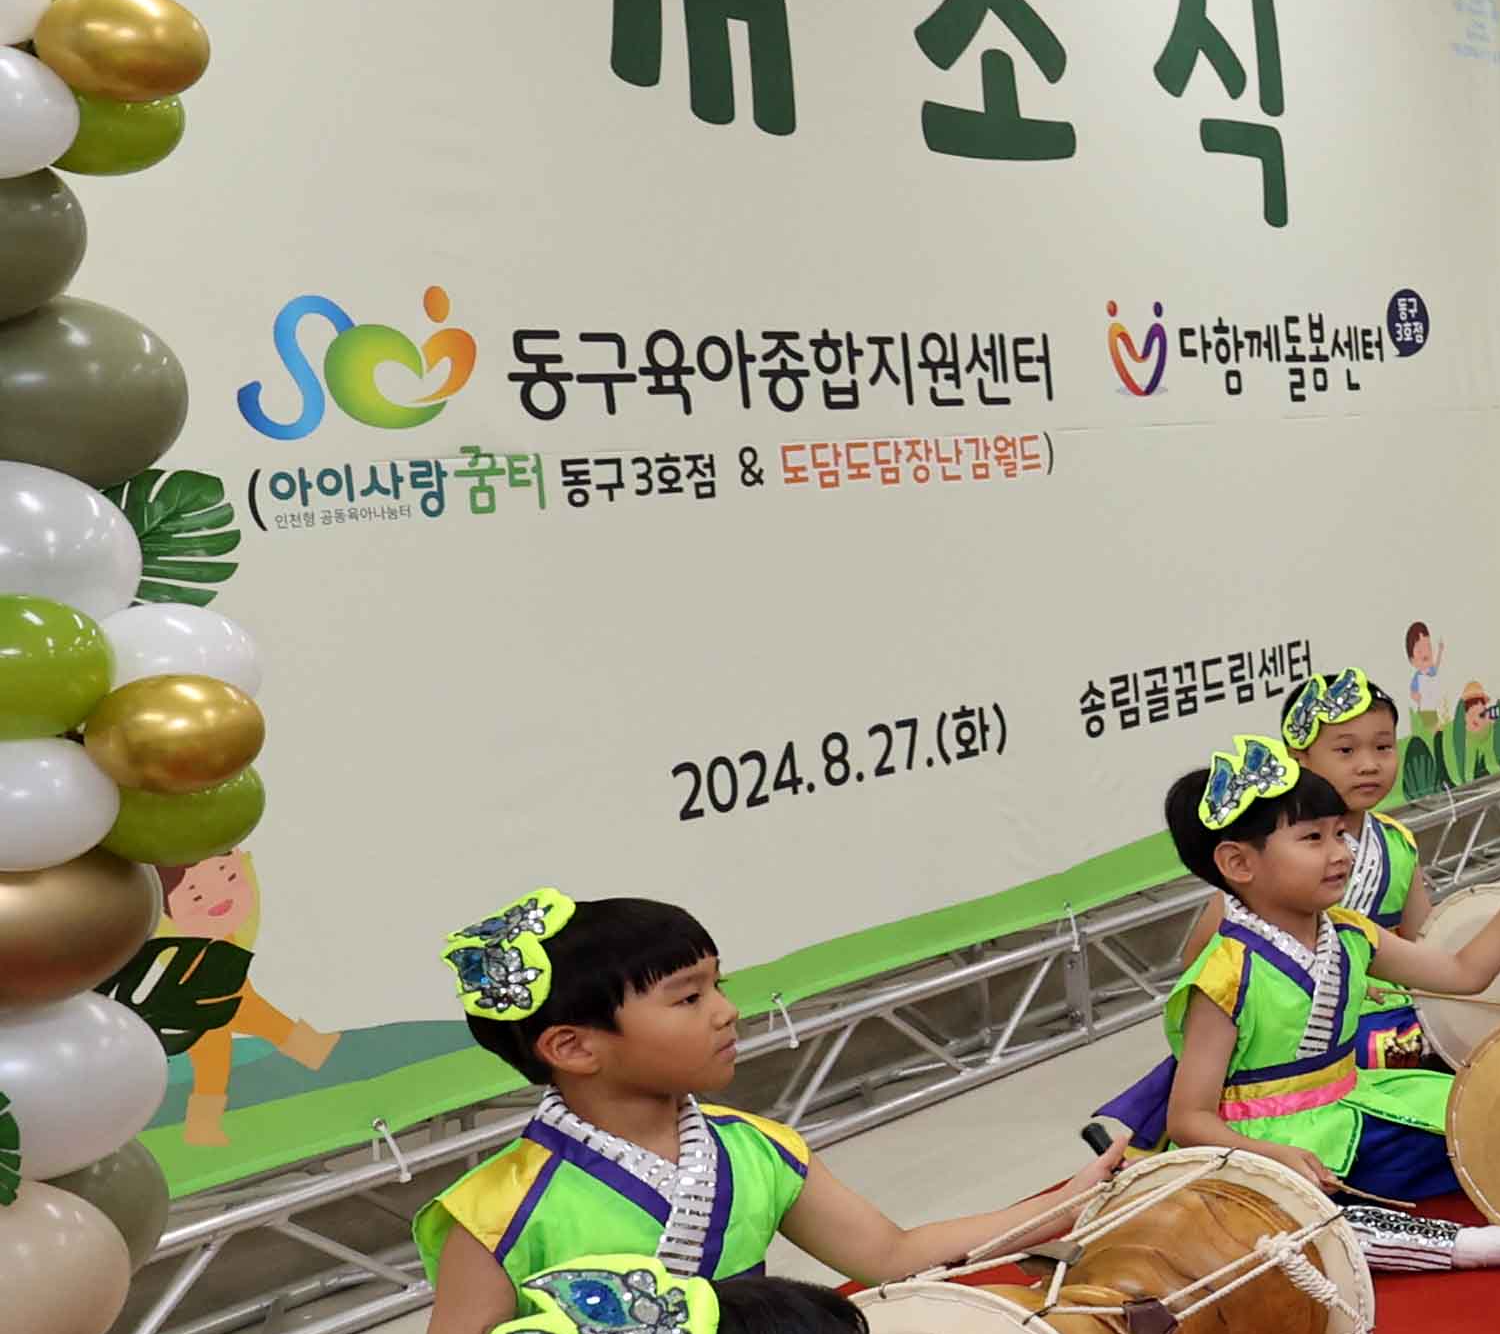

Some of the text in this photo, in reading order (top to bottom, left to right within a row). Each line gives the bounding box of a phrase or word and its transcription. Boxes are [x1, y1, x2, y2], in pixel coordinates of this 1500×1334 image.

[1394, 321, 1425, 344] 3호점
[1397, 297, 1418, 321] 동구
[507, 328, 1054, 421] 동구육아종합지원센터
[1178, 312, 1385, 402] 다함께돌봄센터
[738, 445, 765, 488] &
[1079, 639, 1313, 739] 송림골꿈드림센터
